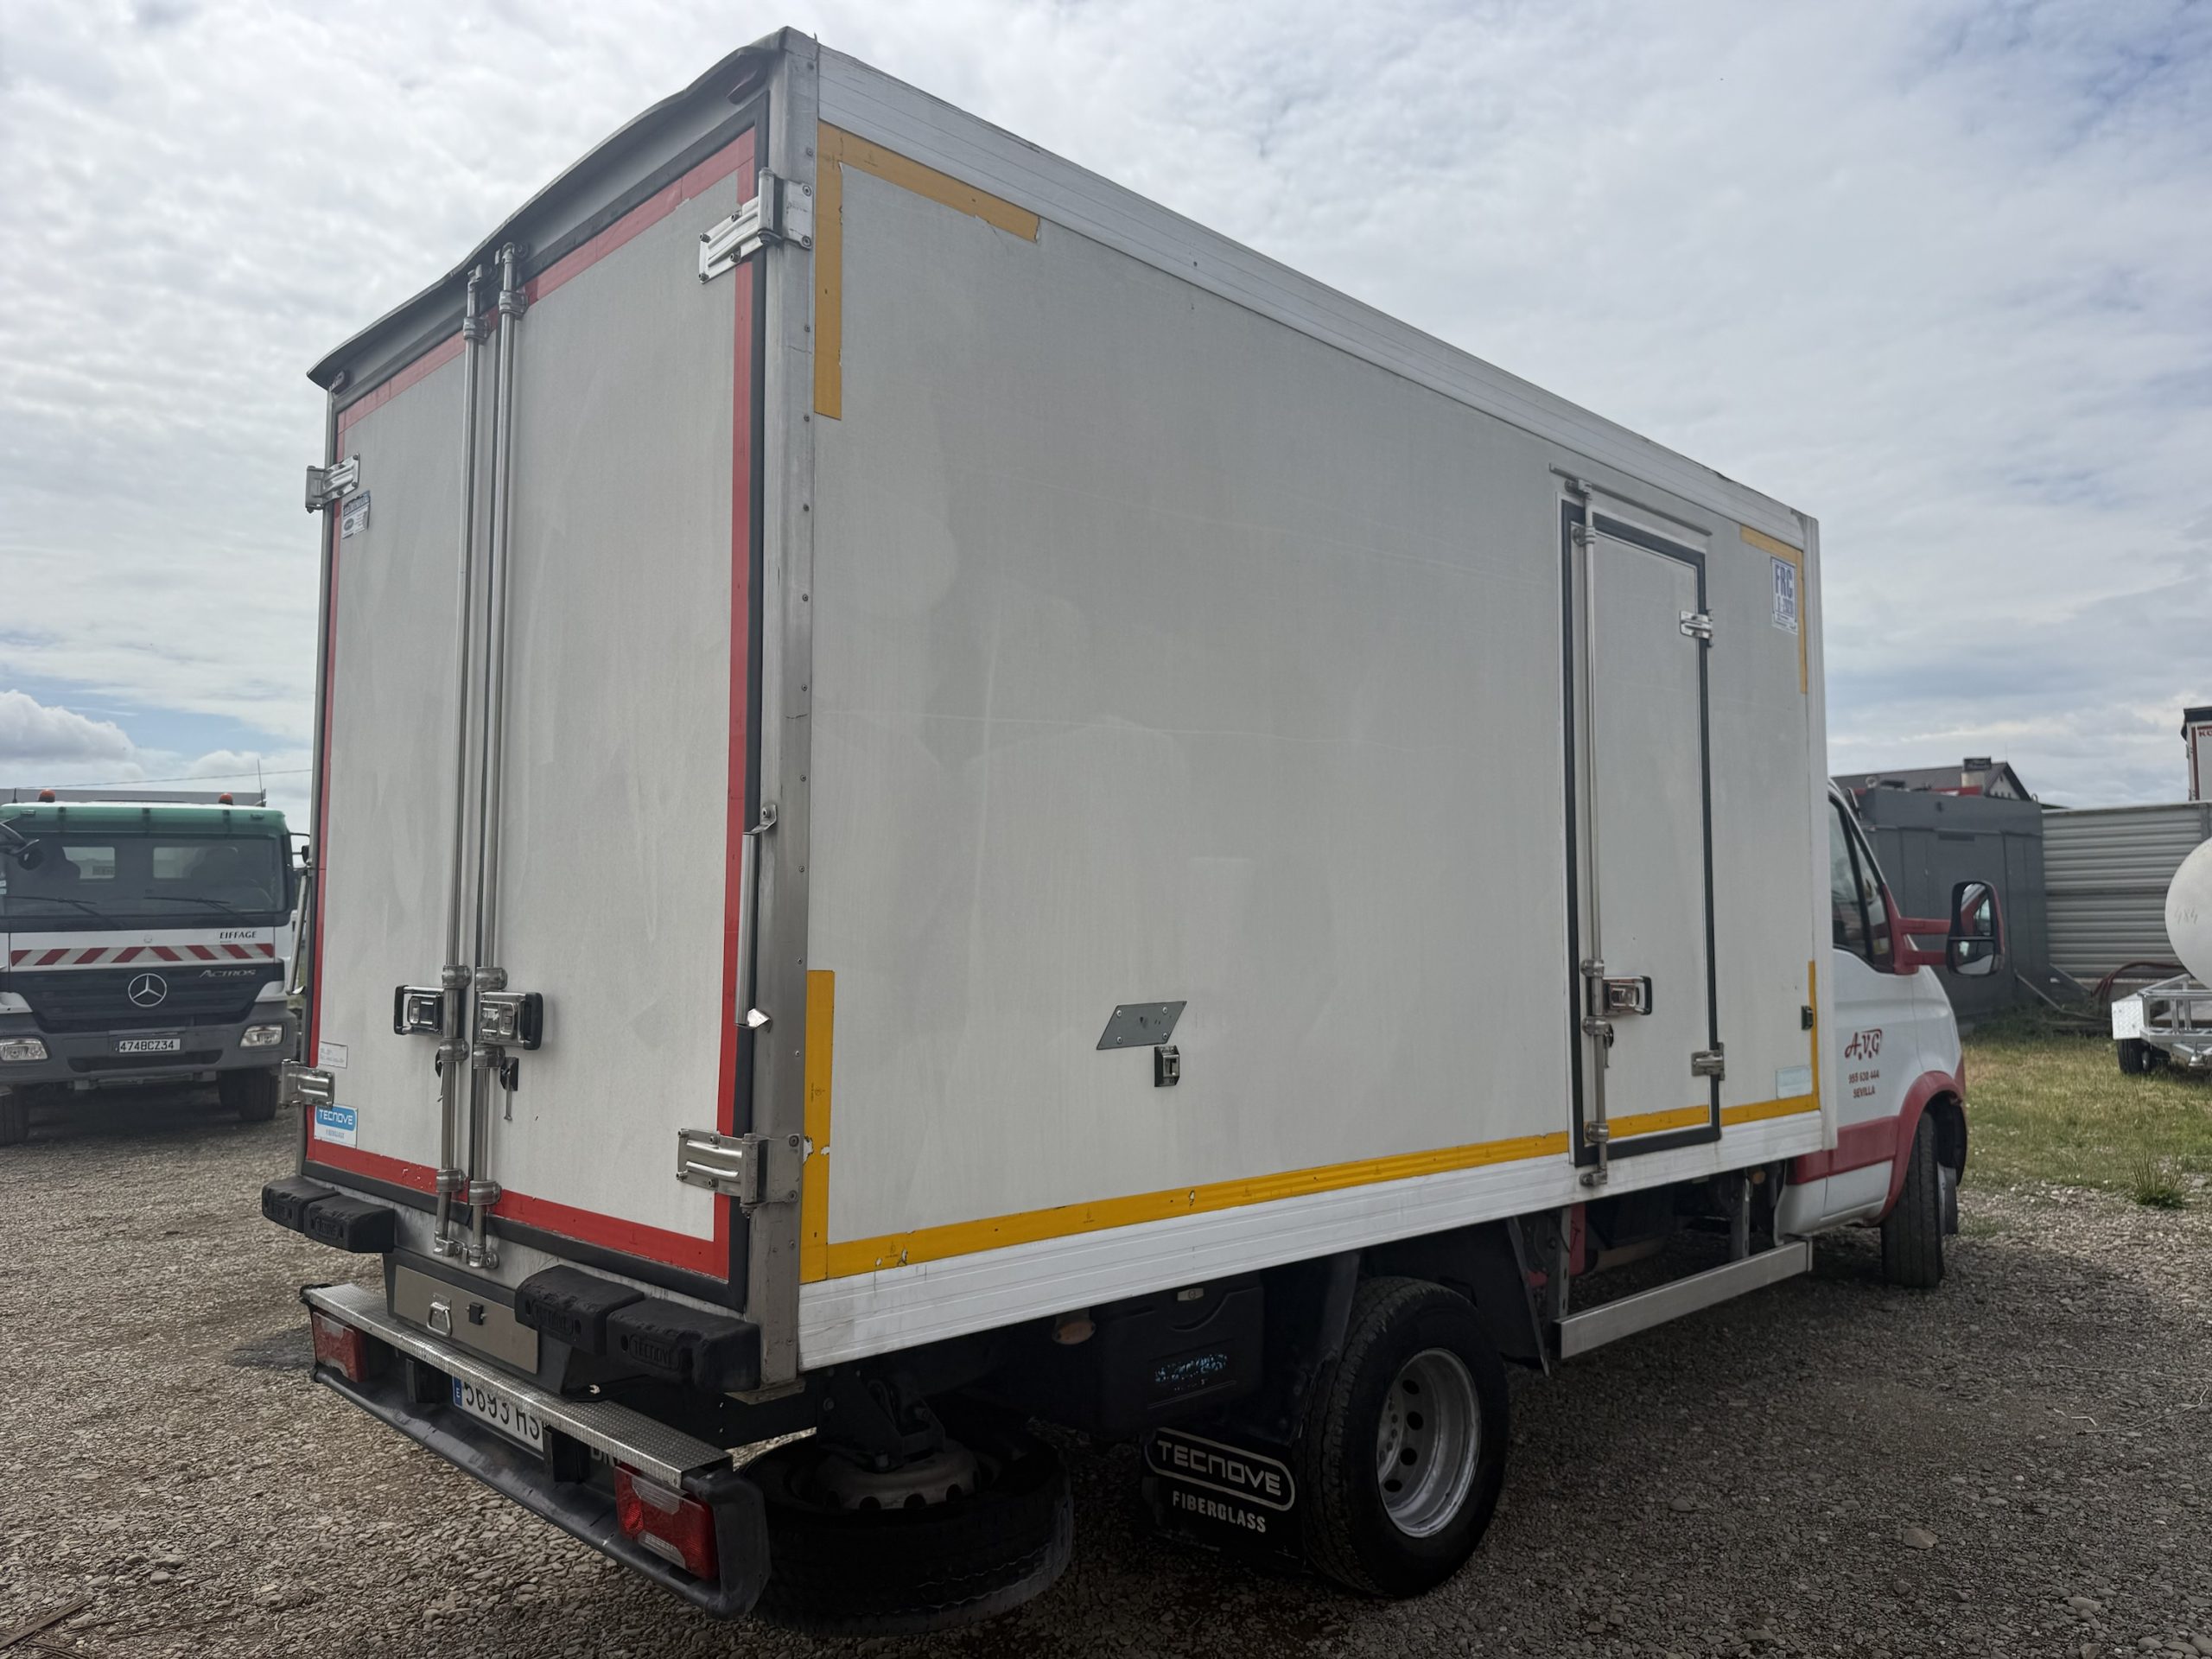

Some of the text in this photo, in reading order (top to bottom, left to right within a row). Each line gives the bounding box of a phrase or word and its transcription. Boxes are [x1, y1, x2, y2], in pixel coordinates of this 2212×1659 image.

[219, 931, 257, 939] EIFFAGE
[120, 1040, 174, 1052] 4748CZ34
[1853, 1084, 1875, 1098] SEVILLA
[319, 1109, 353, 1125] TECNOVE
[1157, 1440, 1282, 1497] TECNOVE
[1172, 1490, 1267, 1534] FIBERGLASS
